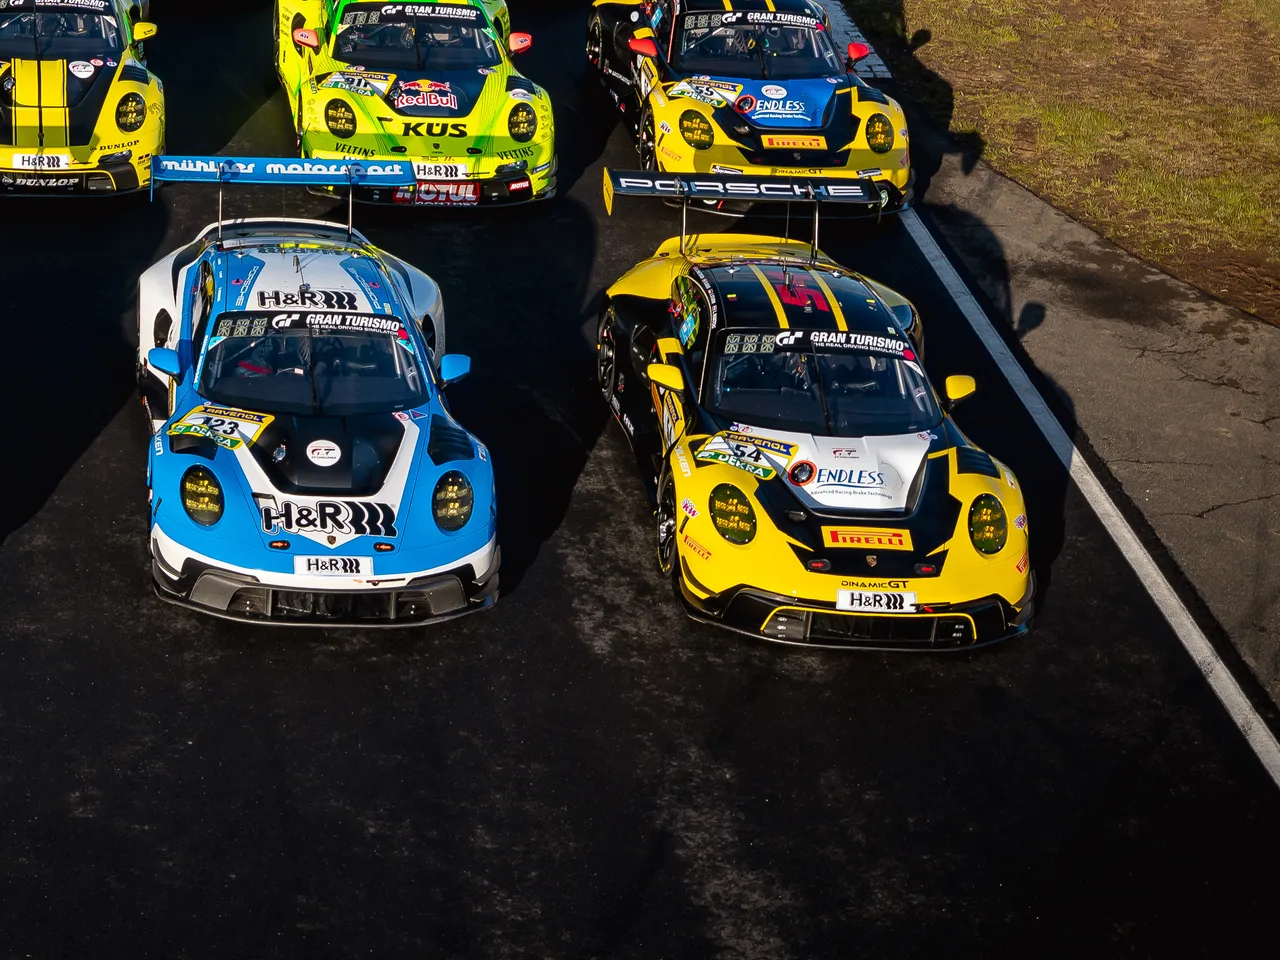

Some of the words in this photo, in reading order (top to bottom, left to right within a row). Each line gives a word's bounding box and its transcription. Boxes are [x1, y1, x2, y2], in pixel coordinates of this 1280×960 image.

[405, 5, 434, 15] GRAN
[434, 6, 477, 18] TURISMO
[746, 11, 774, 22] GRAN
[775, 12, 817, 26] TURISMO
[395, 92, 428, 109] Red
[428, 93, 458, 110] Bull
[755, 99, 806, 112] ENDLESS
[402, 121, 468, 138] KÜS
[99, 140, 140, 152] DUNLOP
[334, 141, 377, 158] VELTINS
[767, 137, 821, 148] PIRELLI
[496, 145, 536, 161] VELTINS
[265, 161, 404, 176] motorsport
[16, 177, 80, 187] DUNLOP
[510, 181, 530, 191] MOTUL
[620, 178, 864, 196] PORSCHE
[396, 183, 478, 202] MOTUL
[235, 265, 260, 307] PORSCHE
[306, 313, 342, 326] GRAN
[344, 315, 401, 331] TURISMO
[364, 327, 399, 337] SIMULATOR
[809, 330, 848, 345] GRAN
[849, 334, 906, 352] TURISMO
[869, 346, 905, 357] SIMULATOR
[206, 408, 261, 422] RAVENOL
[729, 434, 788, 453] RAVENOL
[733, 443, 763, 463] 54
[717, 453, 765, 478] DEKRA
[816, 468, 886, 486] ENDLESS
[836, 489, 853, 497] Racing
[868, 492, 893, 500] Technology
[829, 530, 904, 547] PIRELLI
[683, 534, 712, 562] PIRELLI
